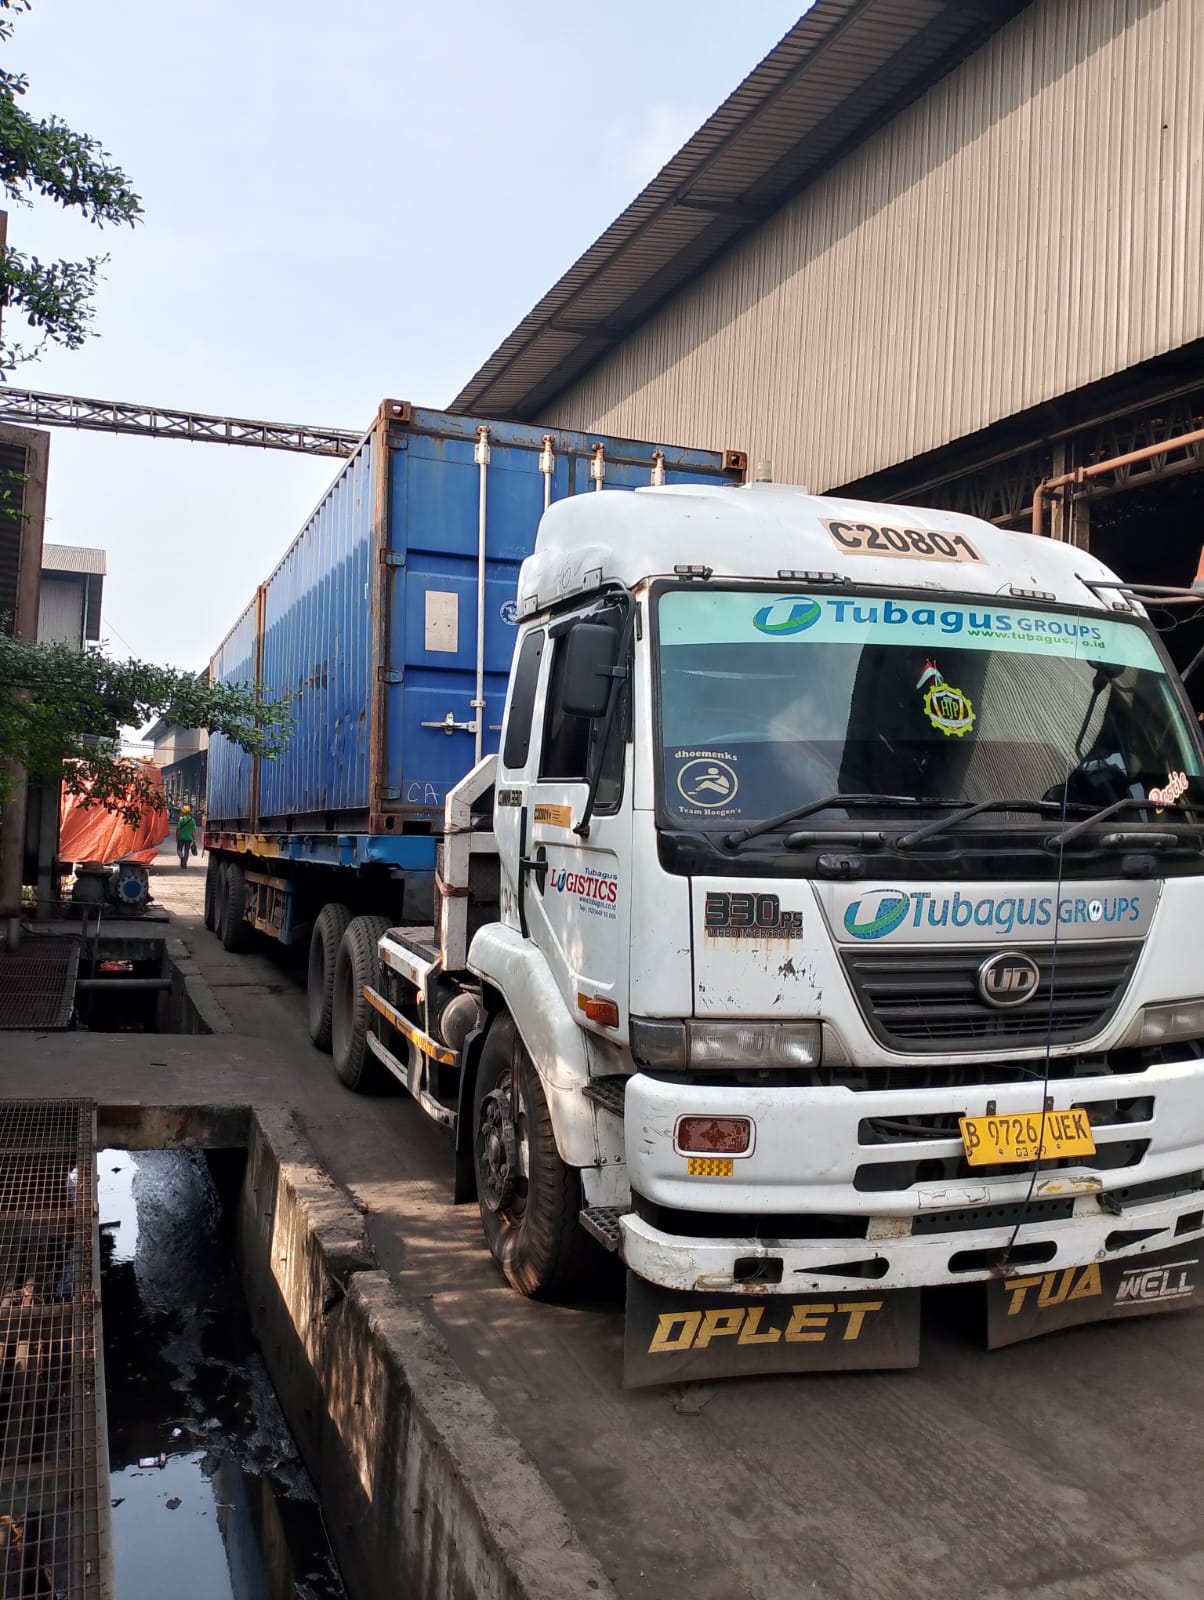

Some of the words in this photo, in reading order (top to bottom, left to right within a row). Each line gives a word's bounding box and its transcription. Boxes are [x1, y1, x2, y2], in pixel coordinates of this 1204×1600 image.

[828, 521, 980, 561] C20801
[826, 600, 1013, 634] Tubagus
[1017, 617, 1102, 640] GROUPS
[967, 629, 1106, 649] www.tubagus.o.id
[674, 750, 738, 761] dhoemenks
[678, 806, 703, 815] Team
[584, 867, 618, 880] Tubagus
[706, 892, 780, 928] 330
[780, 911, 803, 929] PS
[909, 891, 1053, 935] Tubagus
[987, 967, 1036, 992] UD
[965, 1121, 981, 1148] B
[987, 1117, 1038, 1146] 9726
[1047, 1113, 1088, 1142] UEK
[1004, 1263, 1103, 1316] TUA
[1115, 1270, 1195, 1301] WELL
[647, 1301, 884, 1353] OPLET
